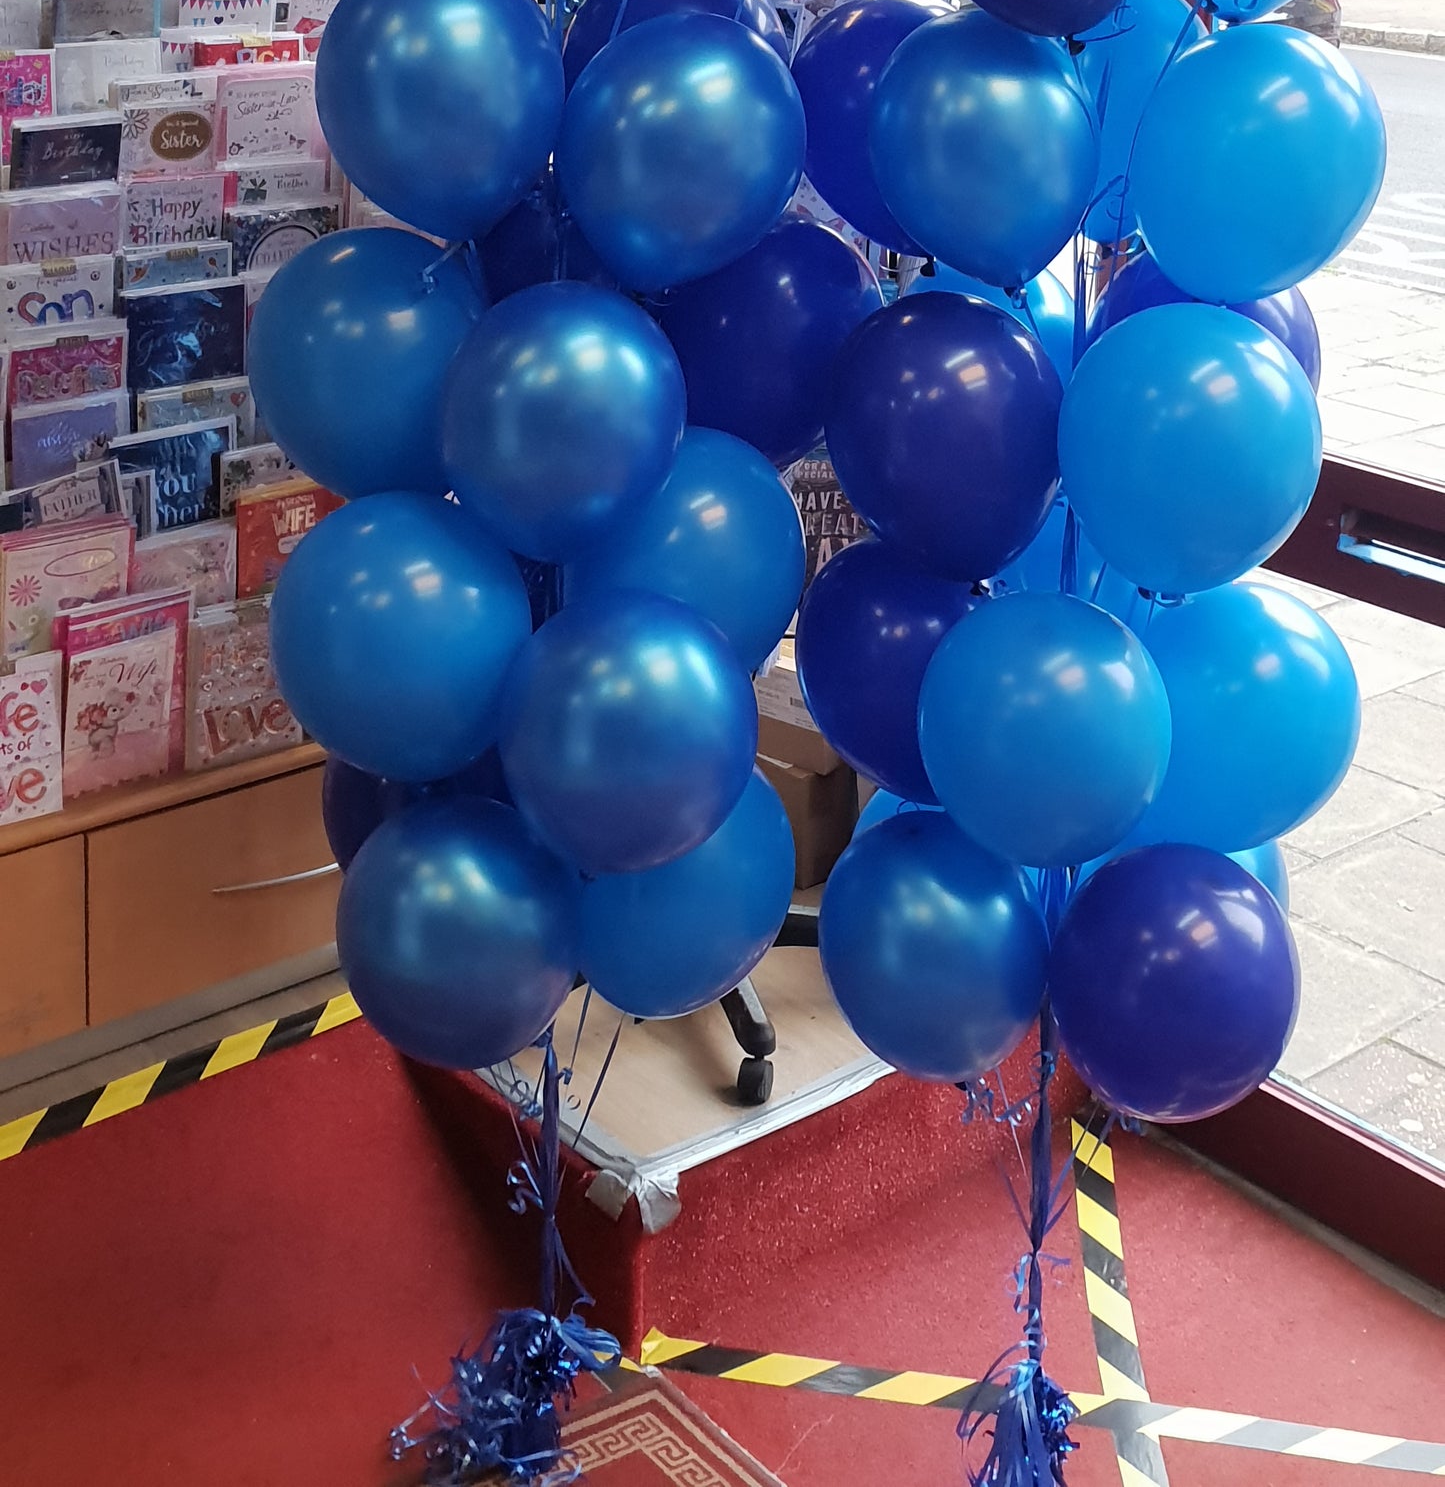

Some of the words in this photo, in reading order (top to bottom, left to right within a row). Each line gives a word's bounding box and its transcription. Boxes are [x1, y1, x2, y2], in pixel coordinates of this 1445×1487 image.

[160, 129, 204, 150] Sister
[151, 197, 201, 220] Happy
[132, 223, 216, 246] Birthday
[13, 232, 114, 264] WISHES
[800, 471, 835, 479] PECIAL
[272, 504, 317, 536] WIFE
[805, 512, 861, 536] REAT
[17, 734, 34, 752] of
